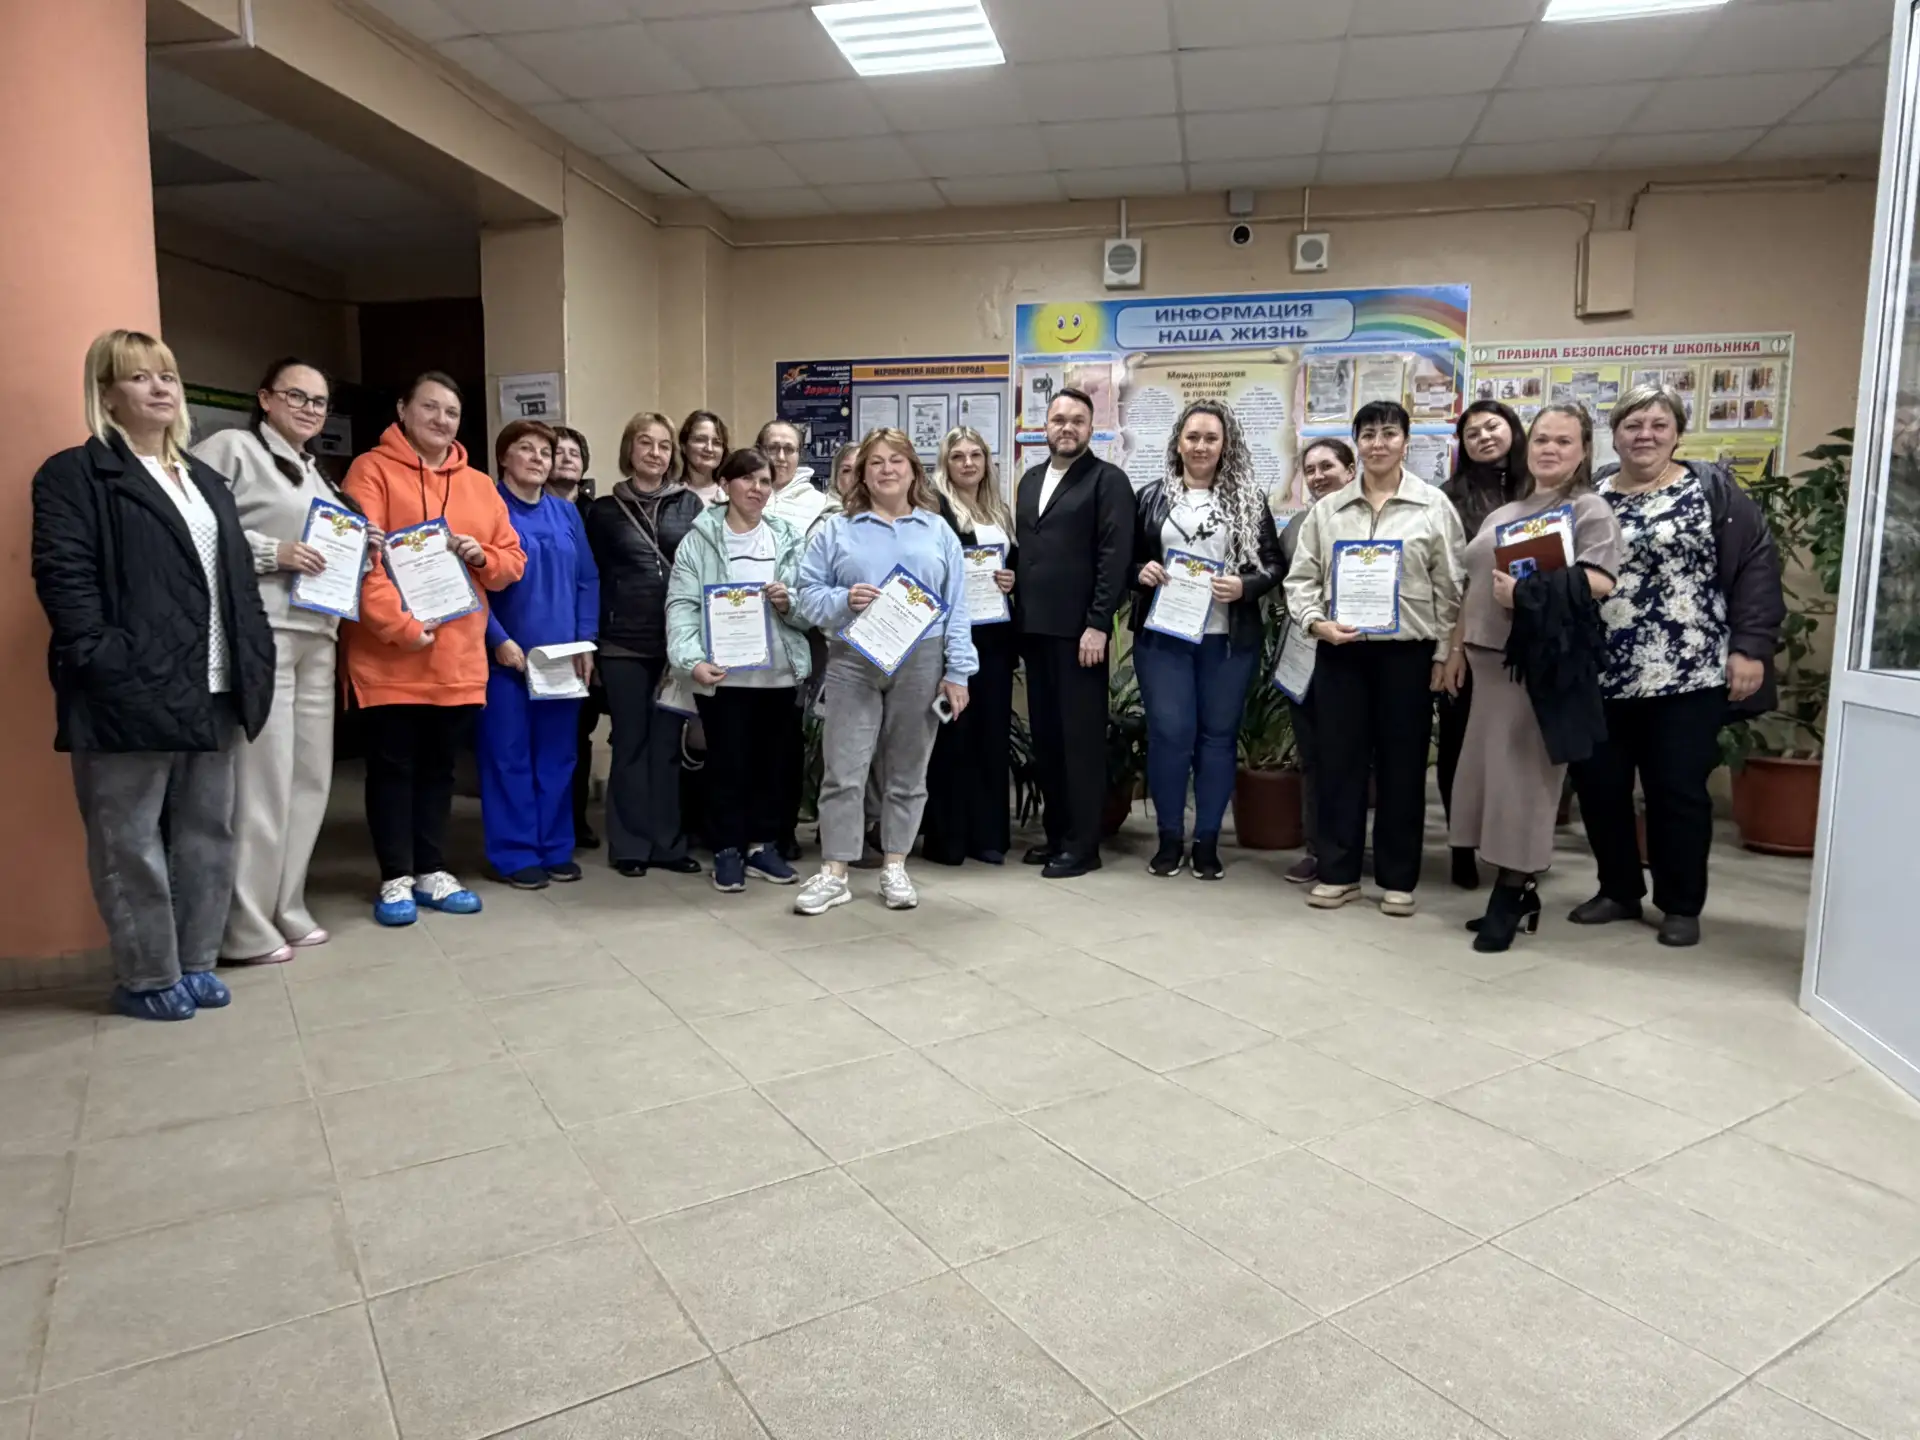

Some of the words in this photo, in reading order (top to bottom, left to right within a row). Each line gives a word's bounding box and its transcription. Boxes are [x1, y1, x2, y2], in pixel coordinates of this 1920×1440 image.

[1155, 302, 1314, 324] ИНФОРМАЦИЯ
[1158, 326, 1223, 344] НАША
[1231, 323, 1309, 342] ЖИЗНЬ
[1497, 346, 1559, 360] ПРАВИЛА
[1563, 343, 1669, 358] БЕЗОПАСНОСТИ
[1673, 340, 1761, 355] ШКОЛЬНИКА
[874, 366, 924, 376] МЕРОПРИЯТИЯ
[926, 366, 955, 375] НАШЕГО
[957, 365, 985, 375] ГОРОДА
[1167, 370, 1247, 380] Международная
[1181, 380, 1232, 389] конвенция
[1192, 390, 1229, 399] правах
